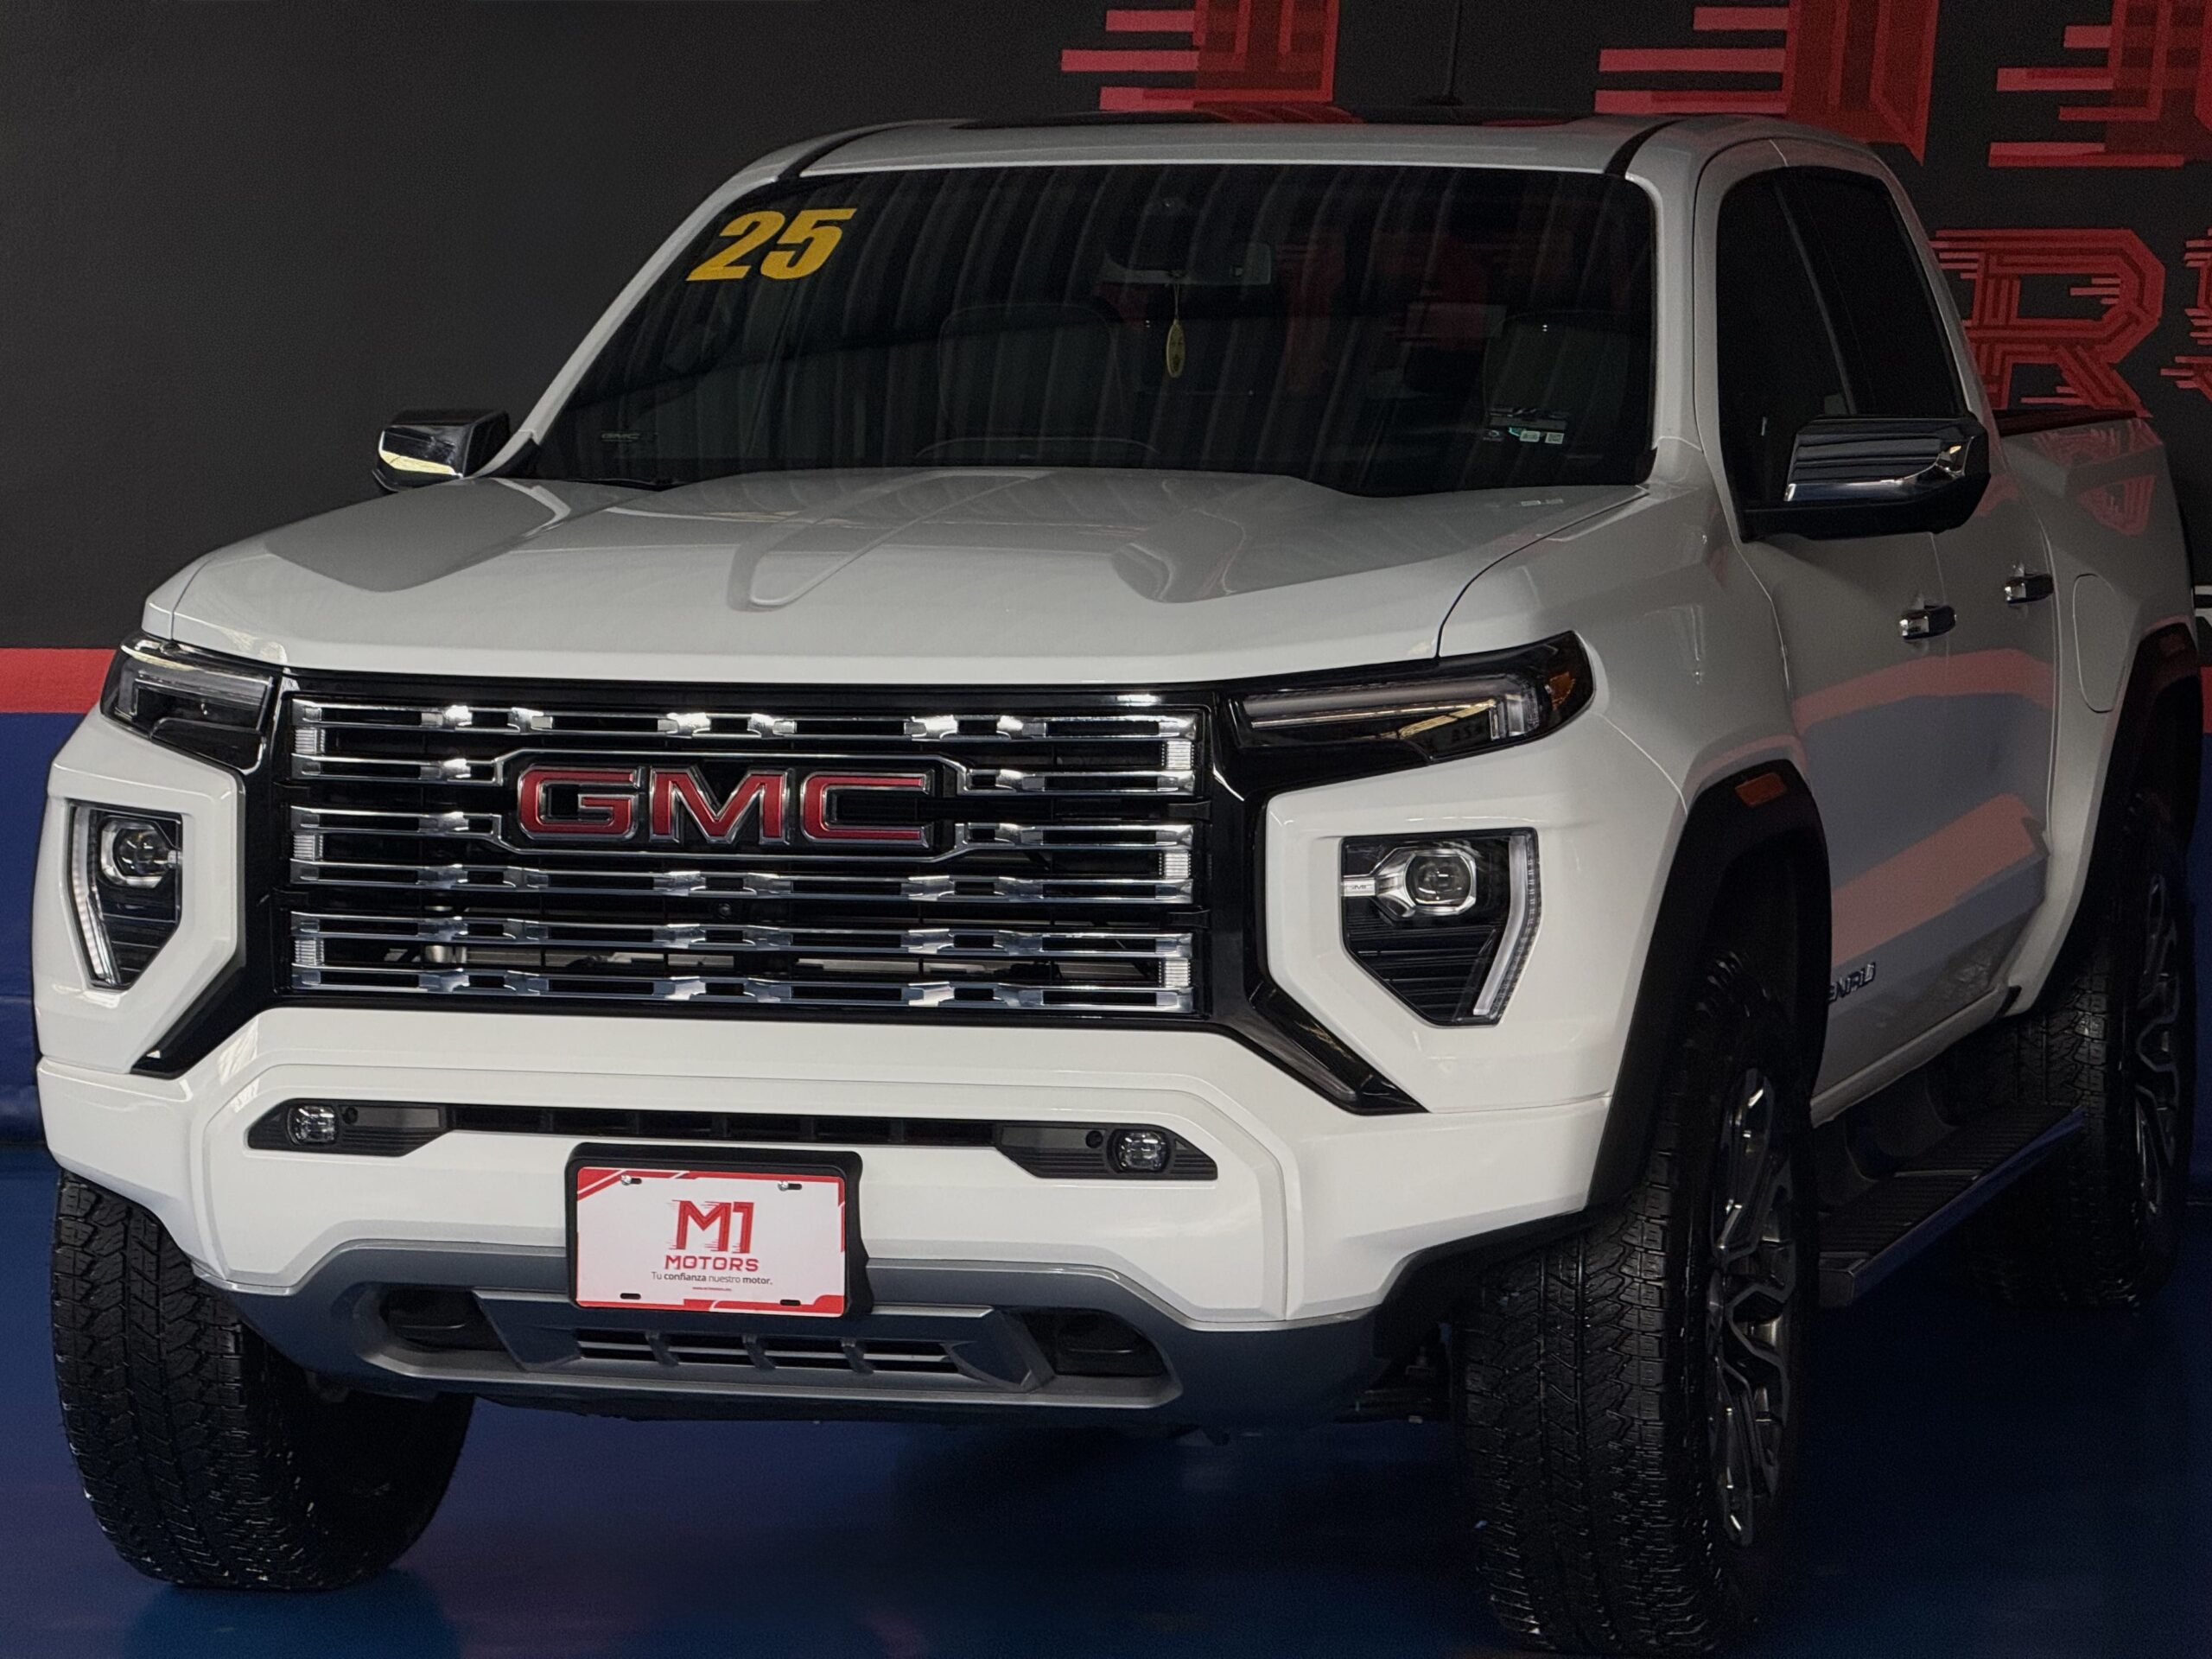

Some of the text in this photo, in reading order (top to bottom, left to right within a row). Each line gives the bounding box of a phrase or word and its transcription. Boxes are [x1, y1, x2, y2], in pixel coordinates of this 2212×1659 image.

[686, 208, 857, 281] 25
[518, 765, 931, 849] GMC
[670, 1199, 754, 1254] M1
[652, 1271, 663, 1281] Tu
[664, 1272, 707, 1282] confianza
[742, 1276, 773, 1286] motor.
[664, 1255, 760, 1272] MOTORS
